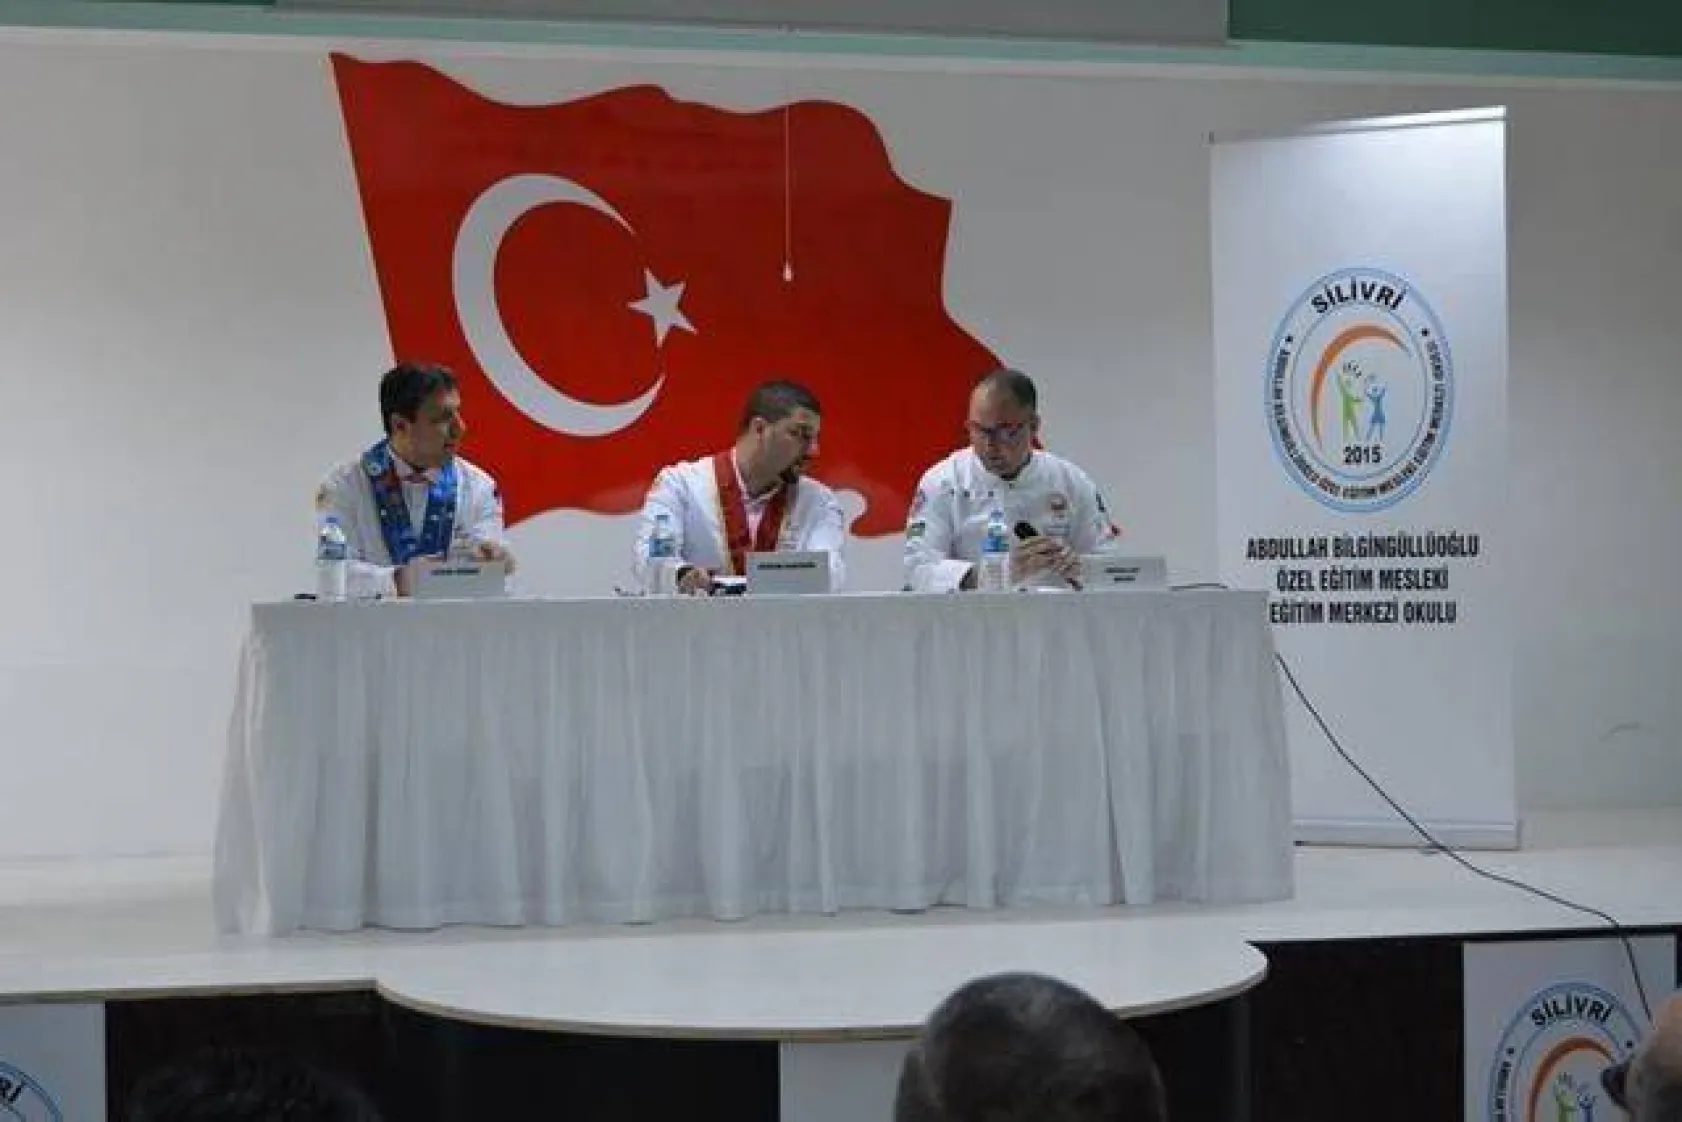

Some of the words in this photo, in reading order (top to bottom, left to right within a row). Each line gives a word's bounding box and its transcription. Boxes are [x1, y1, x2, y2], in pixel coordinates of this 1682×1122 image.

[1343, 446, 1382, 463] 2015
[1247, 538, 1328, 559] ABDULLAH
[1277, 565, 1315, 591] ÖZEL
[1403, 601, 1457, 623] OKULU
